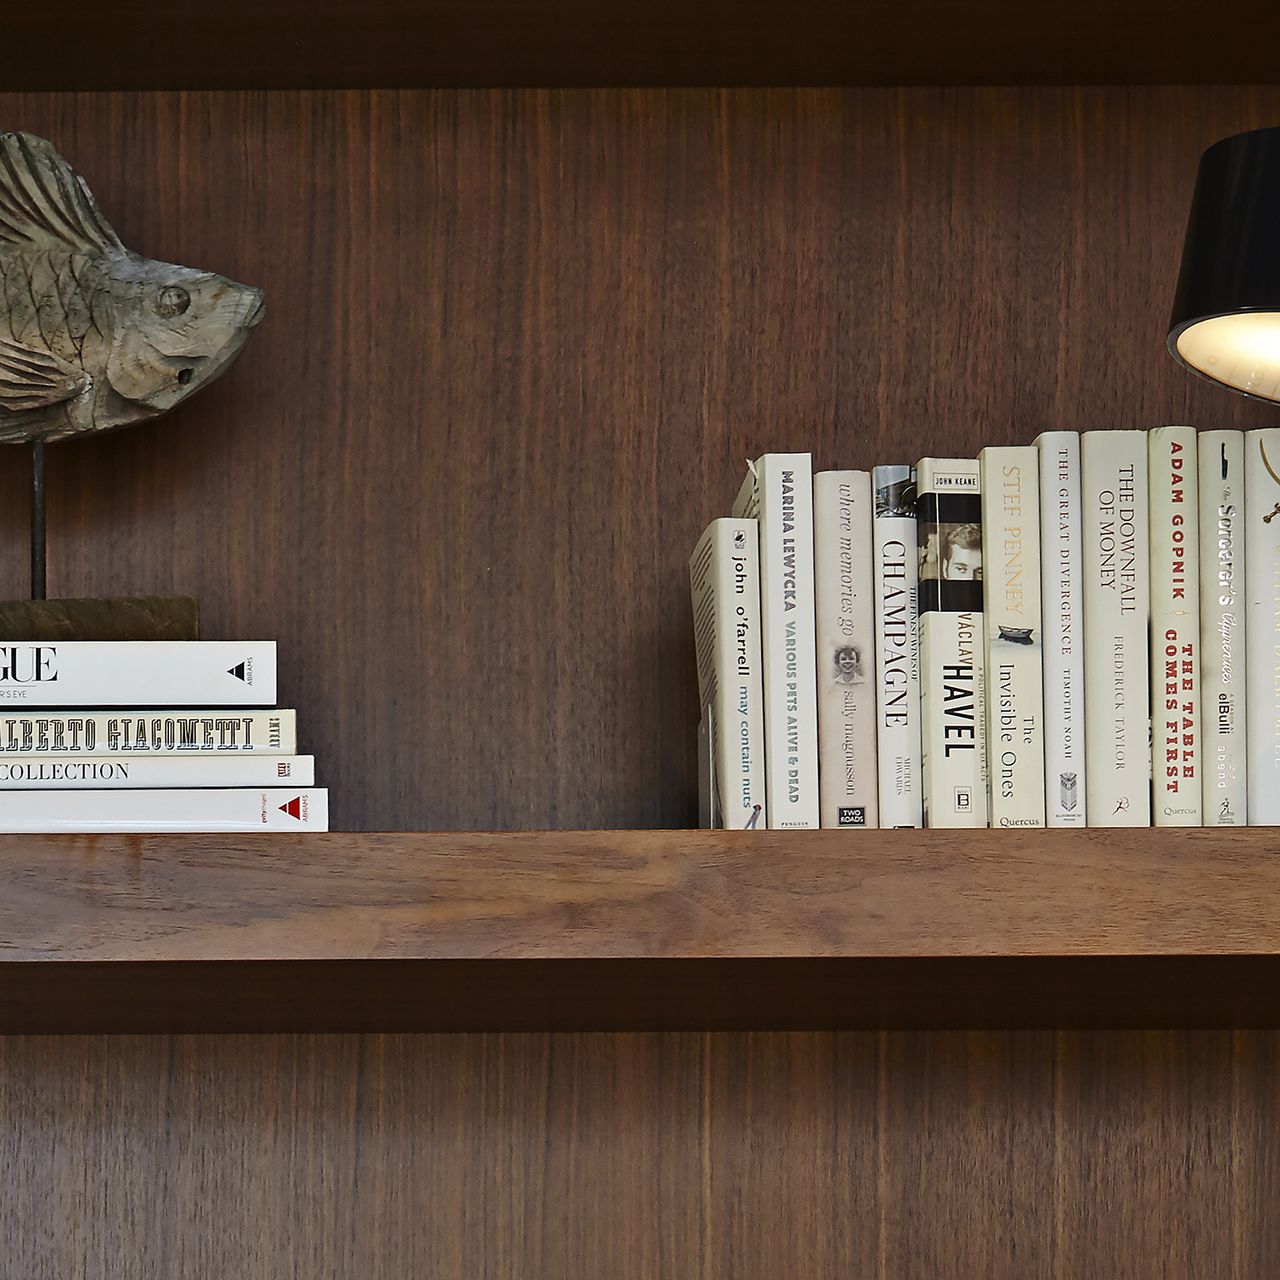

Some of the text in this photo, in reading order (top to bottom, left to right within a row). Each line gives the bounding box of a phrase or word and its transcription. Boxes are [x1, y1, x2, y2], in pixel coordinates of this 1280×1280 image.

[782, 471, 796, 612] MARINA LEWYCKA
[1058, 448, 1071, 655] THE GREAT DIVERGENCE
[1171, 442, 1184, 599] ADAM GOPNIK
[731, 557, 750, 675] john o'farrell
[883, 541, 908, 727] CHAMPAGNE
[958, 612, 975, 665] VÁCLAV
[108, 718, 253, 751] GIACOMETTI
[943, 665, 975, 757] HAVEL
[1000, 664, 1017, 797] Invisible Ones
[1165, 629, 1178, 793] COMES FIRST
[1182, 644, 1194, 778] THE TABLE
